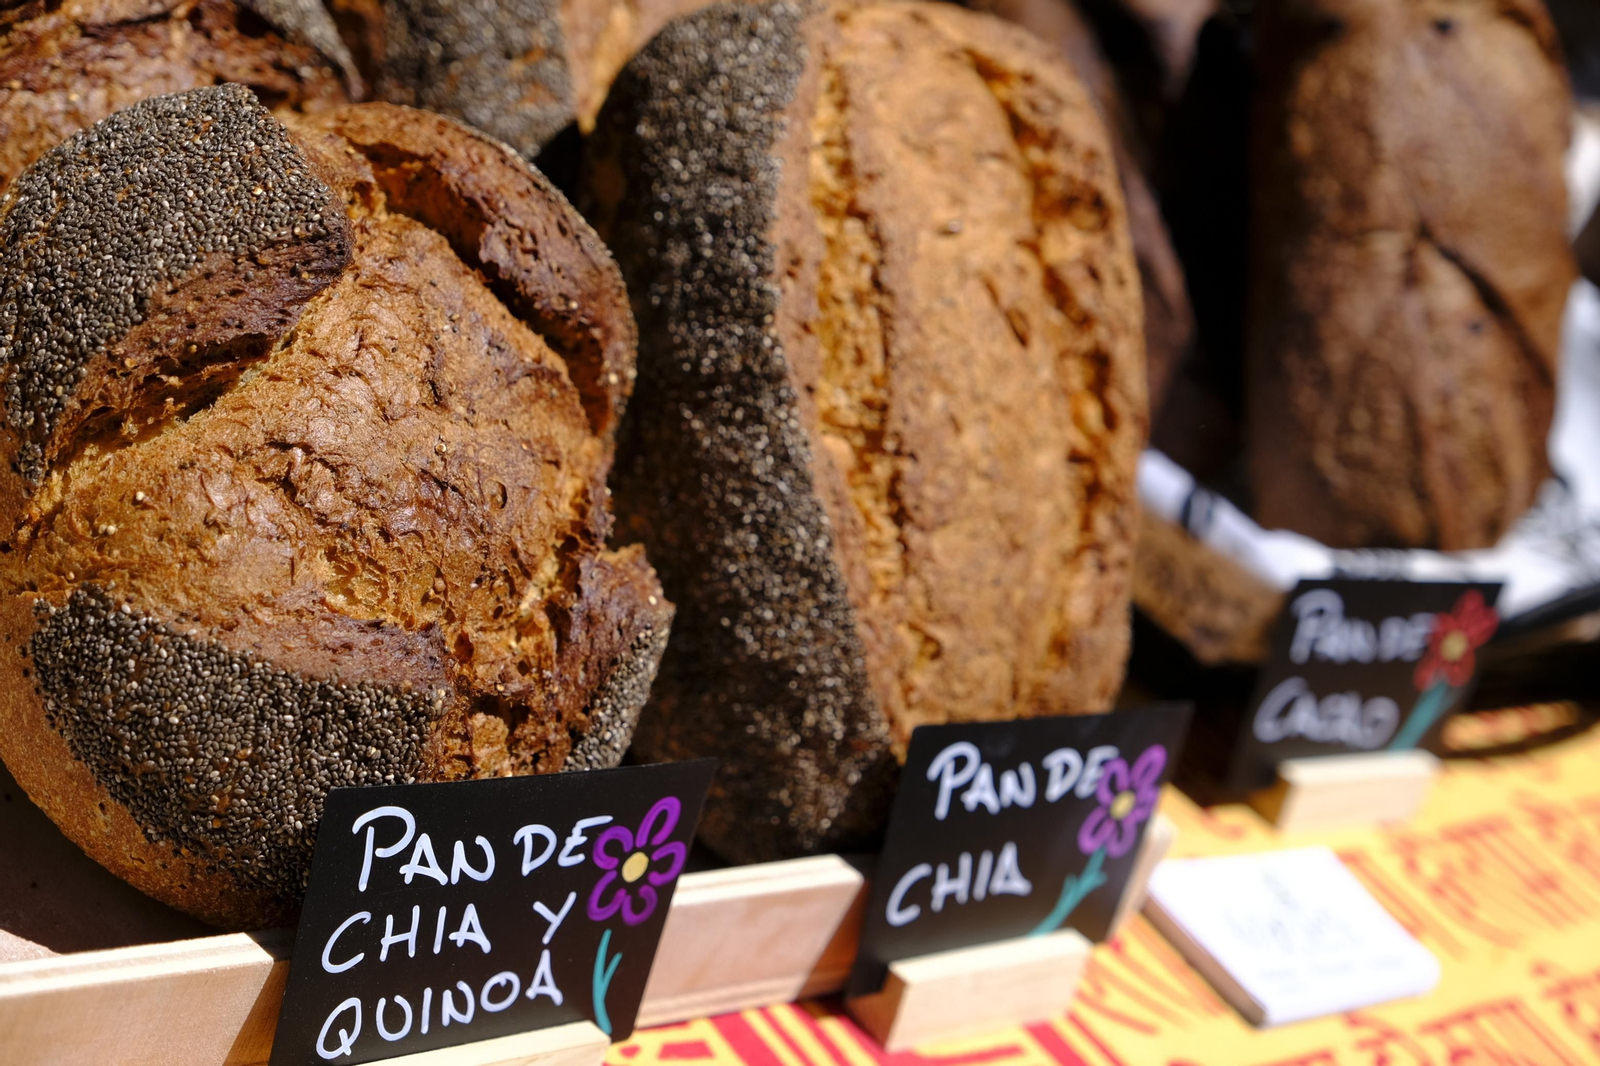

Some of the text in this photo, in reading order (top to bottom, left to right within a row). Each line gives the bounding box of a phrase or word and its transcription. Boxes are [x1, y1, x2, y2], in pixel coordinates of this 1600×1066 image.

[926, 741, 1119, 820] PAN DE
[352, 806, 613, 892] PAN DE
[886, 841, 1032, 926] CHIA
[321, 892, 577, 974] CHIA Y
[316, 949, 563, 1060] QUINOA
